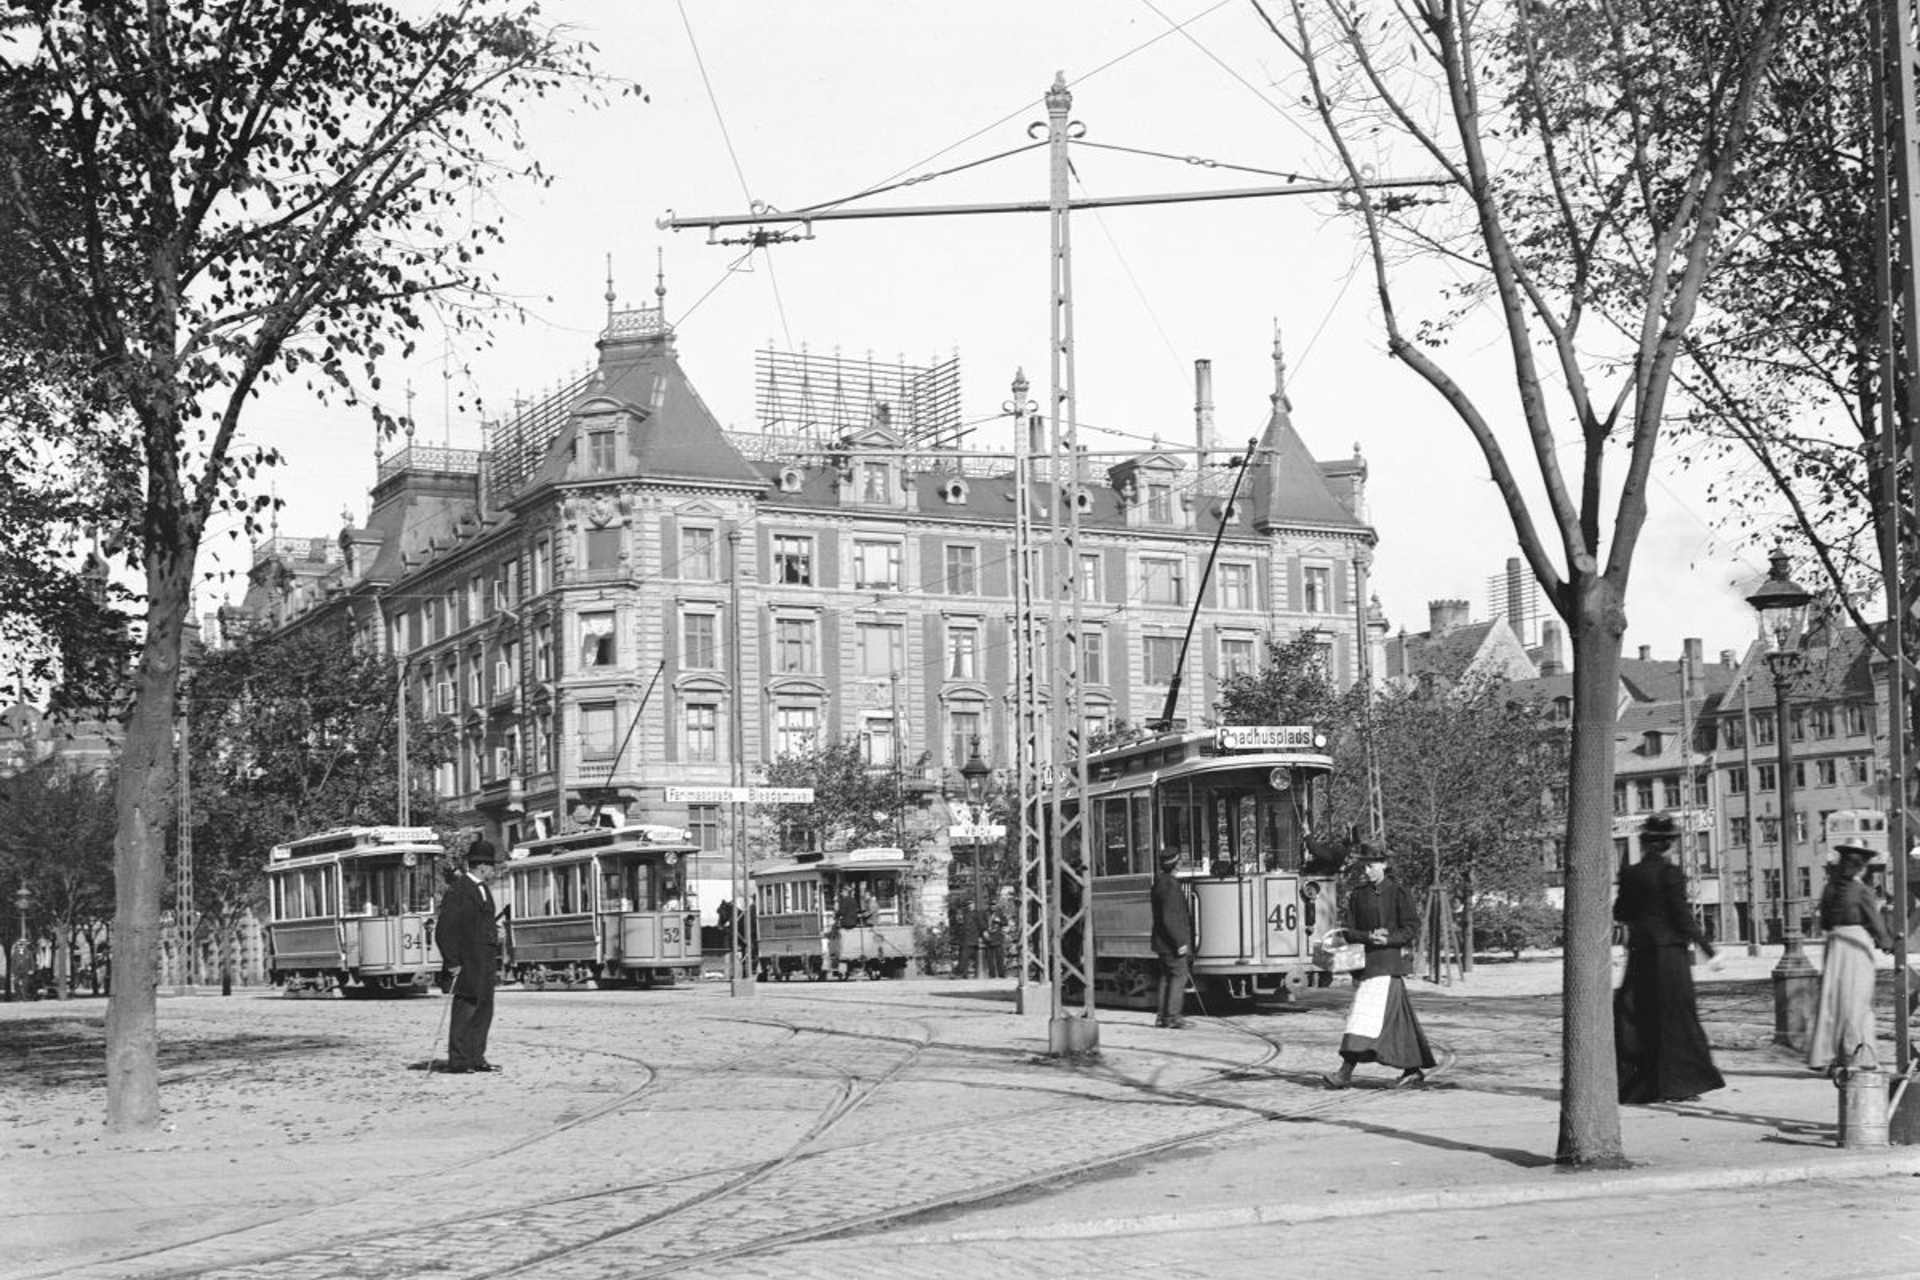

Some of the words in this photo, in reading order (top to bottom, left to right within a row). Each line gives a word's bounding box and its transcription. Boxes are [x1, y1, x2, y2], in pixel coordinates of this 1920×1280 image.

[1268, 903, 1297, 932] 46
[402, 933, 422, 950] 34
[664, 926, 680, 944] 52
